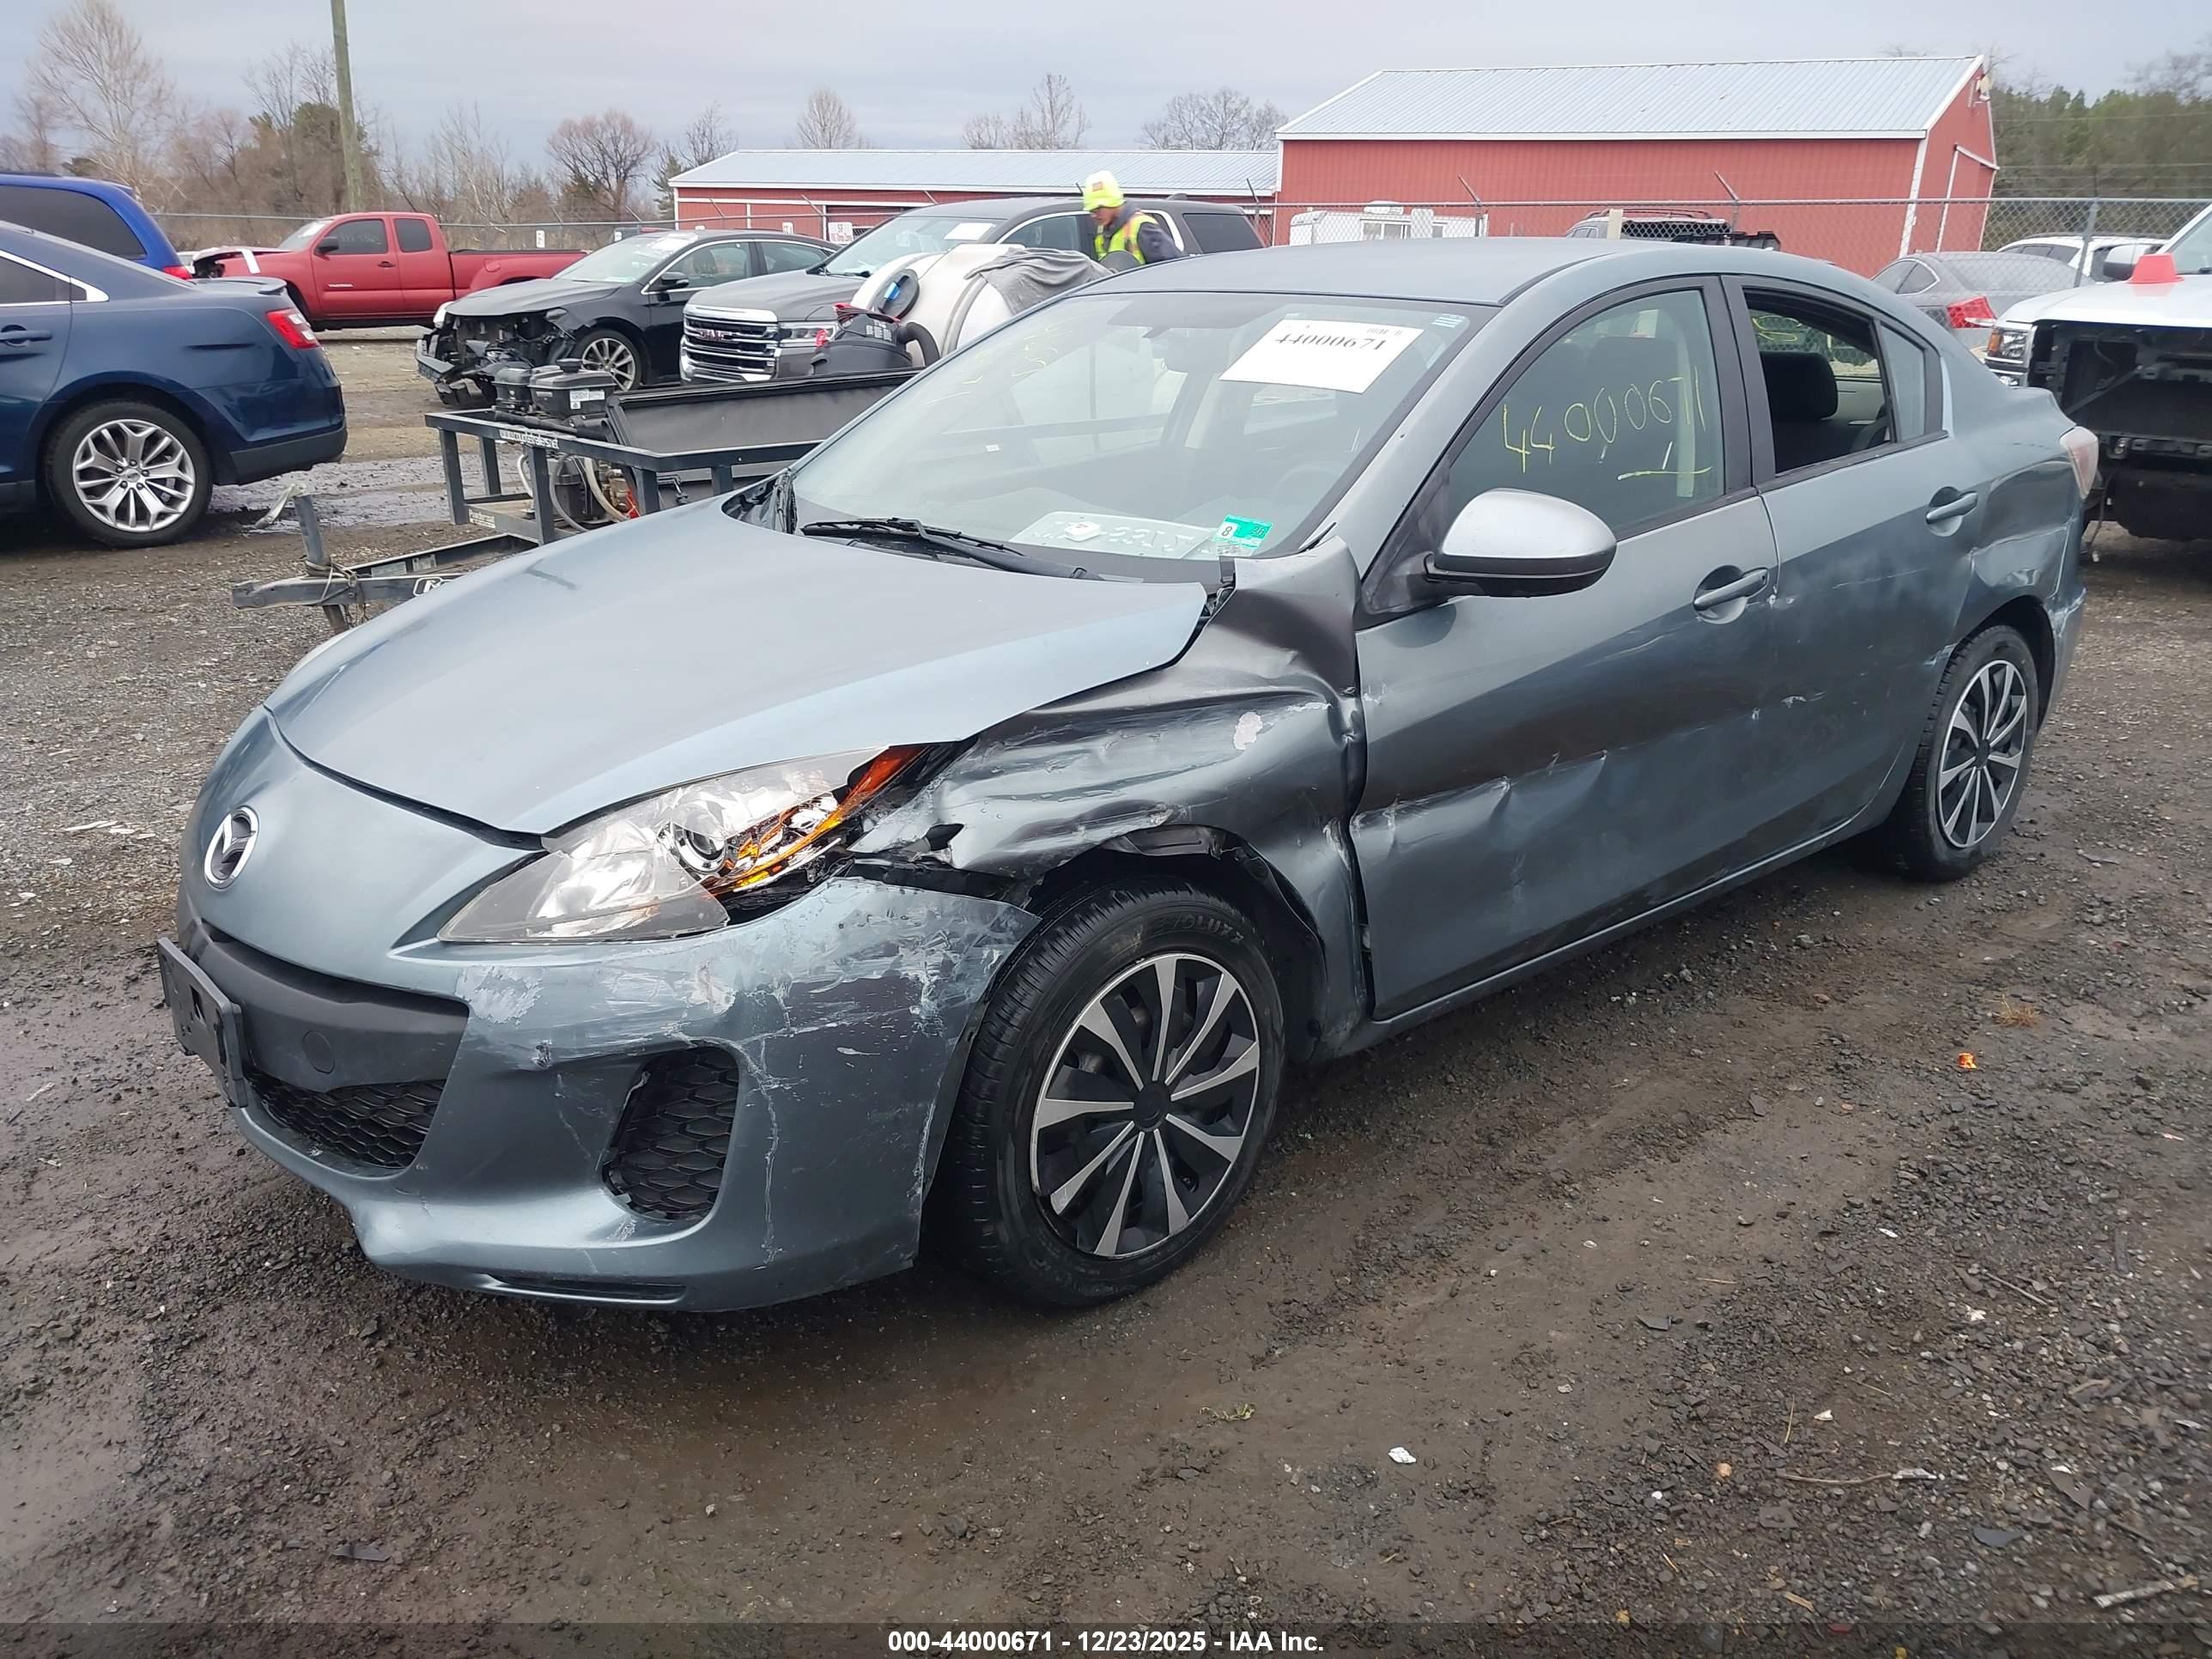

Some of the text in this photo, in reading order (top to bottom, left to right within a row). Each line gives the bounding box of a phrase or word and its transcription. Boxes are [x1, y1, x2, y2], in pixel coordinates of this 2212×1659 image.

[1275, 332, 1388, 350] 44000671
[1221, 526, 1233, 537] 8
[1250, 525, 1266, 538] 26
